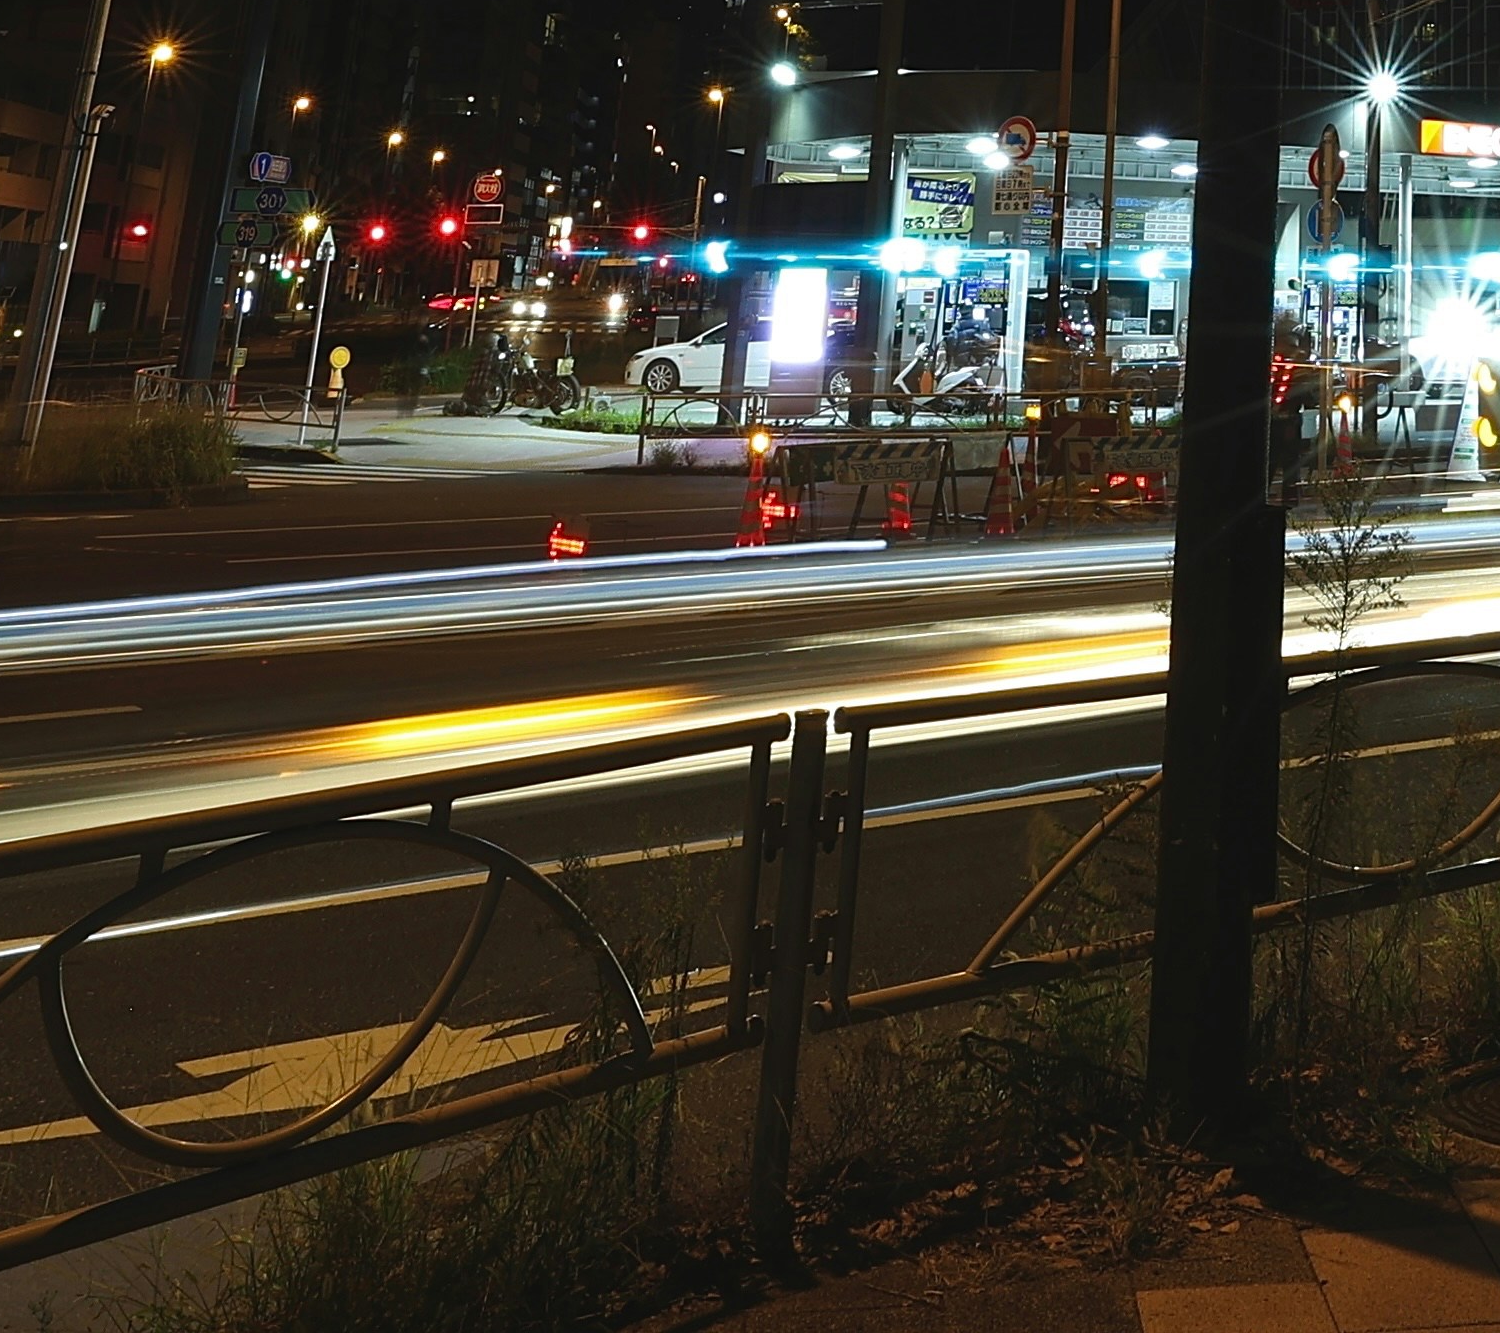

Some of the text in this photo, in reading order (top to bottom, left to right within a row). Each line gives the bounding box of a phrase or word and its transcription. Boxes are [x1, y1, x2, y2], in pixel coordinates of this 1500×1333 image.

[261, 158, 268, 175] 1
[259, 193, 284, 209] 301
[237, 226, 256, 242] 319
